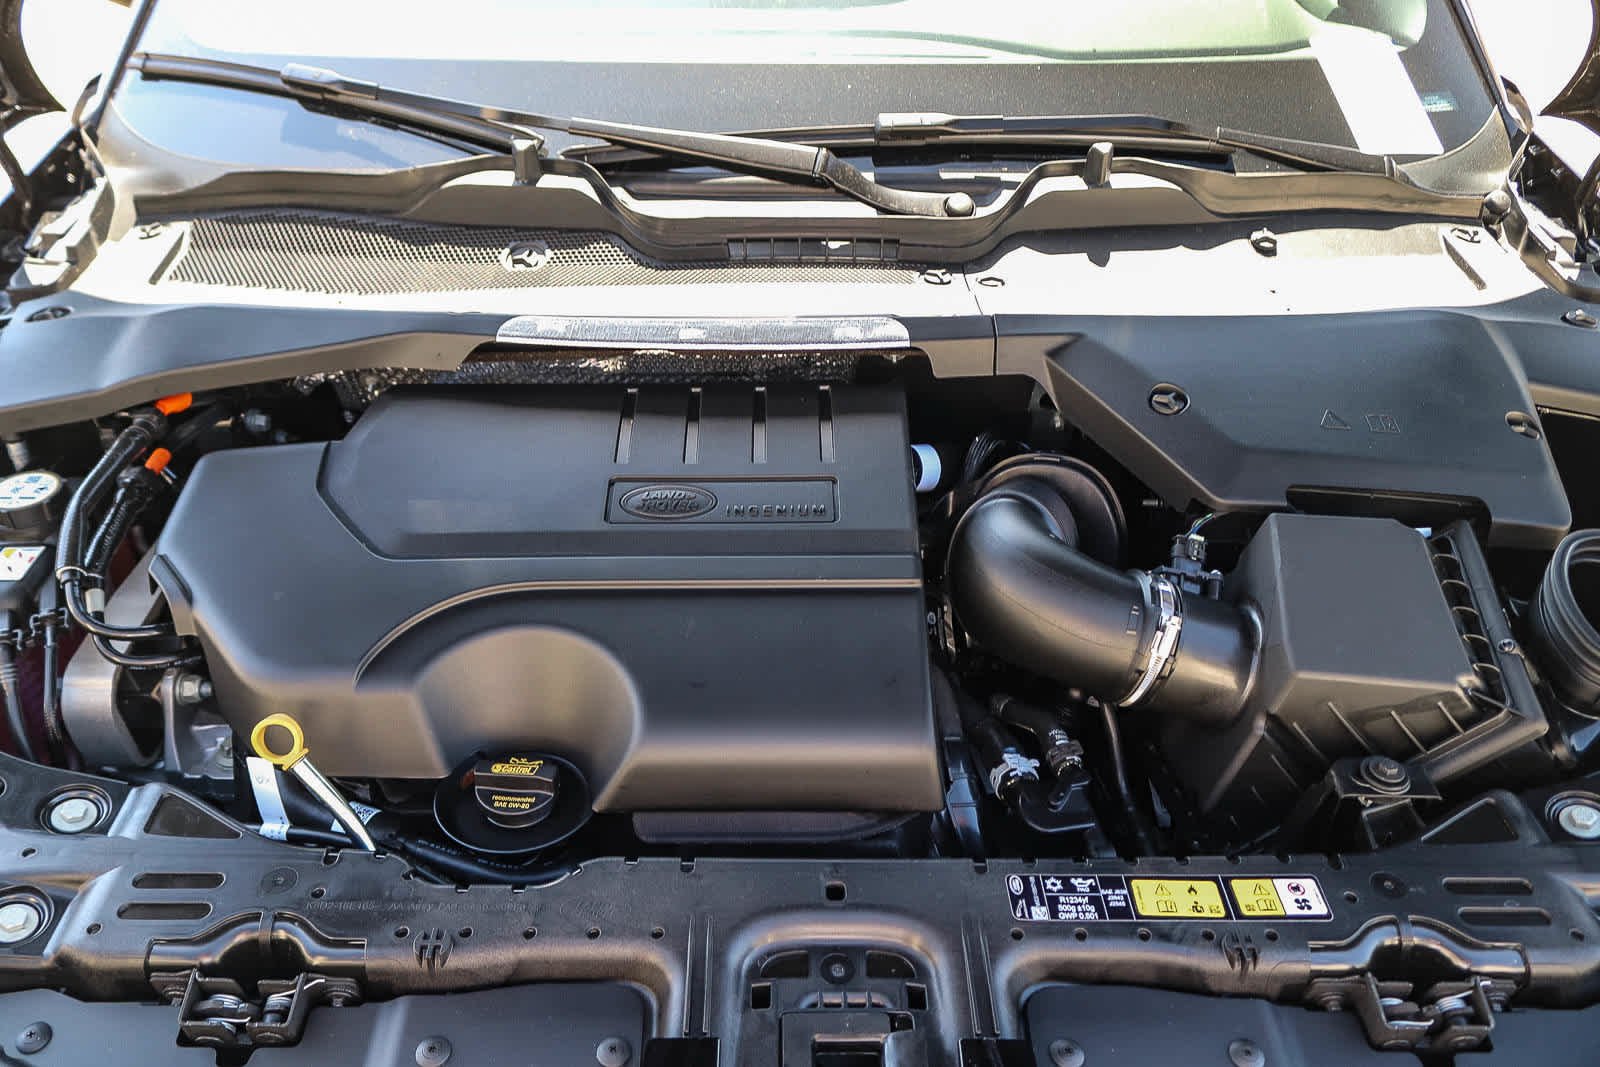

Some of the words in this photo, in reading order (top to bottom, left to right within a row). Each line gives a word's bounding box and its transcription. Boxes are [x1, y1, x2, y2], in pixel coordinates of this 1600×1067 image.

[726, 504, 826, 518] INGENIUM
[492, 795, 536, 803] recommended
[1059, 896, 1089, 904] R1234yf
[1058, 904, 1076, 912] 500g
